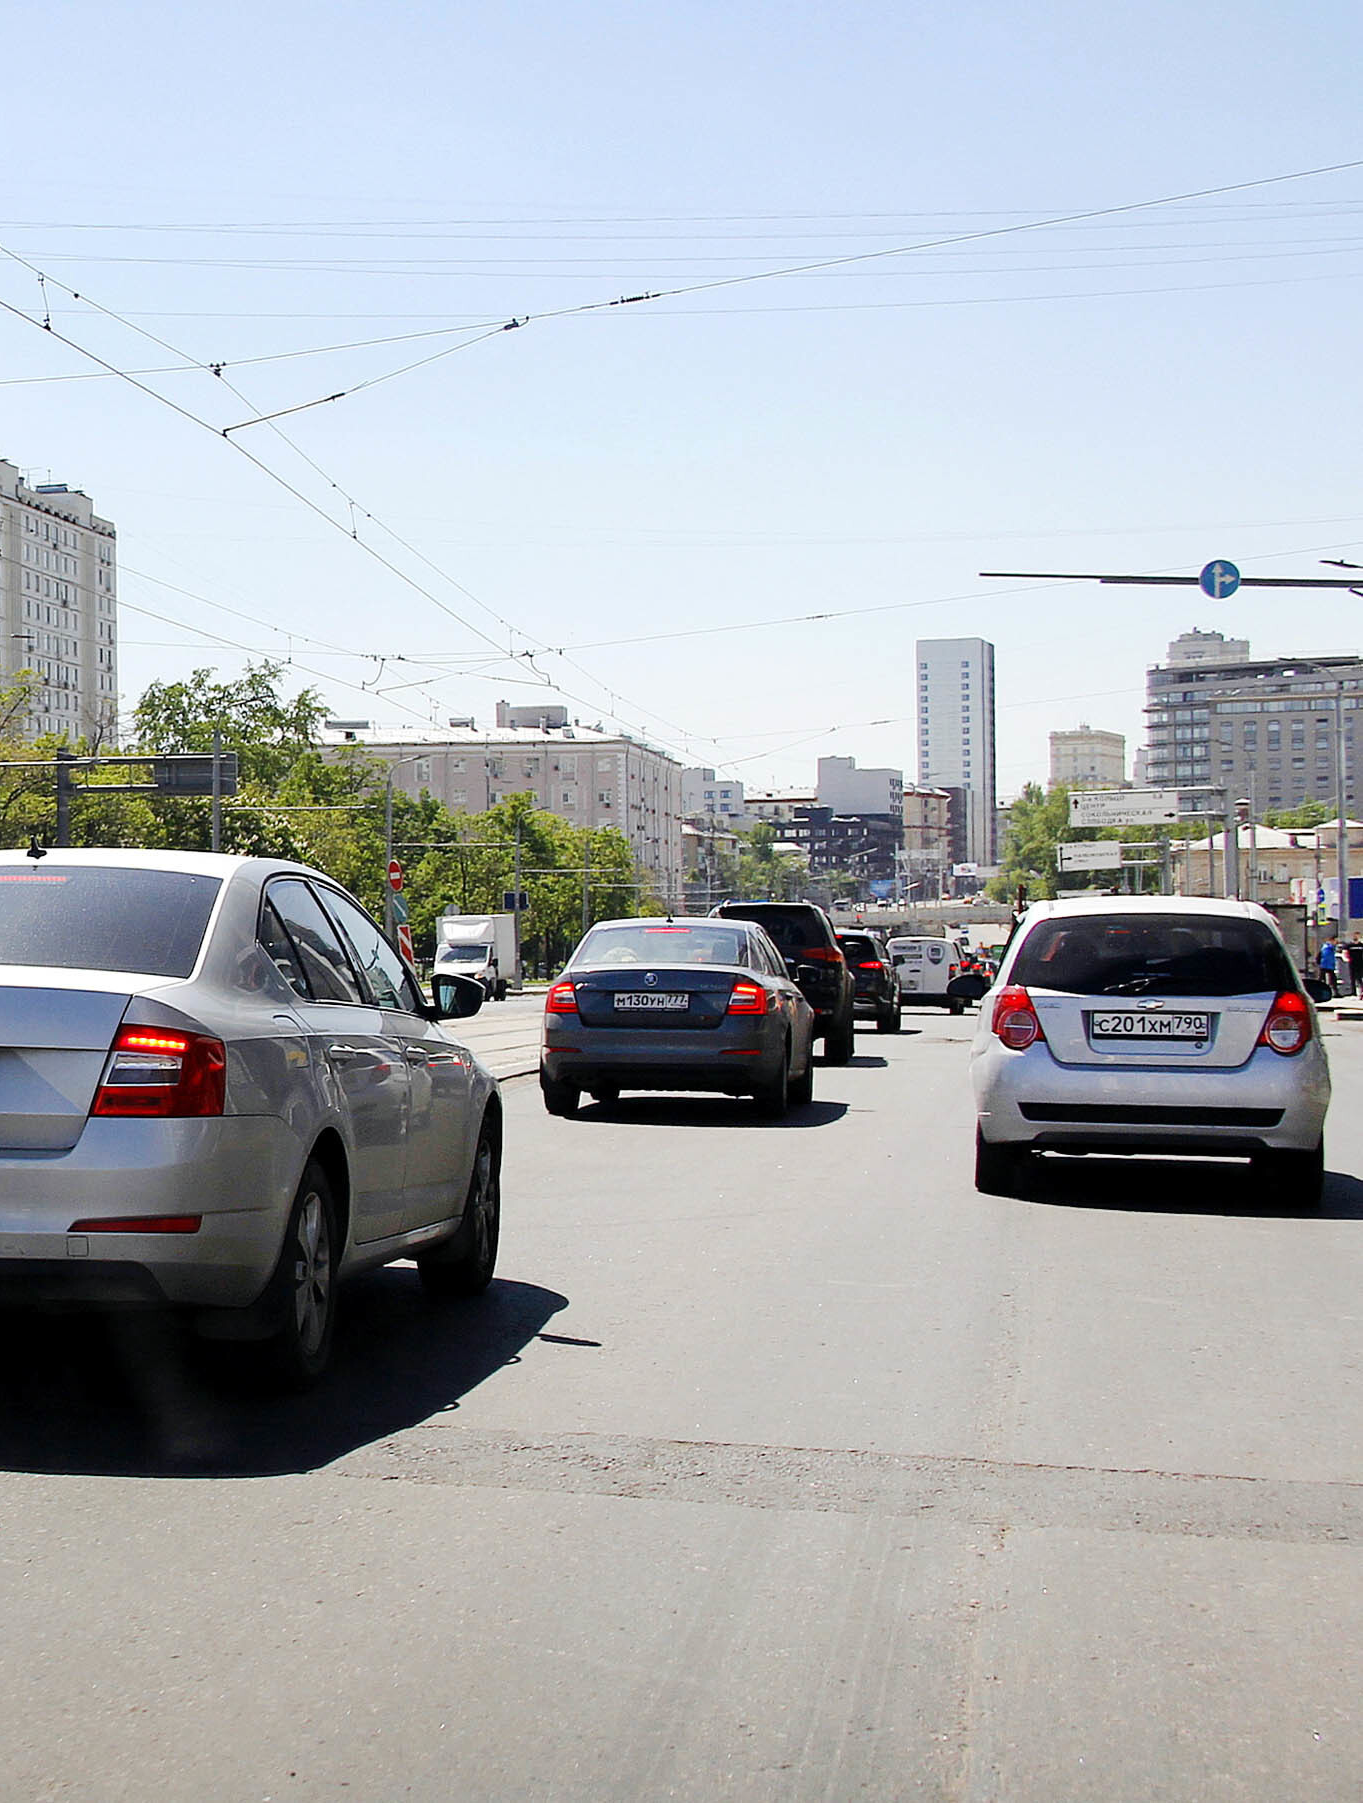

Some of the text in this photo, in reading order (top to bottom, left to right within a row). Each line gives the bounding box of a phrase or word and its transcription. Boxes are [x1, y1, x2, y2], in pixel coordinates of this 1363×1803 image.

[615, 995, 664, 1006] М130УН
[667, 995, 685, 1004] 777
[1099, 1015, 1172, 1033] С201ХМ
[1175, 1016, 1201, 1029] 790
